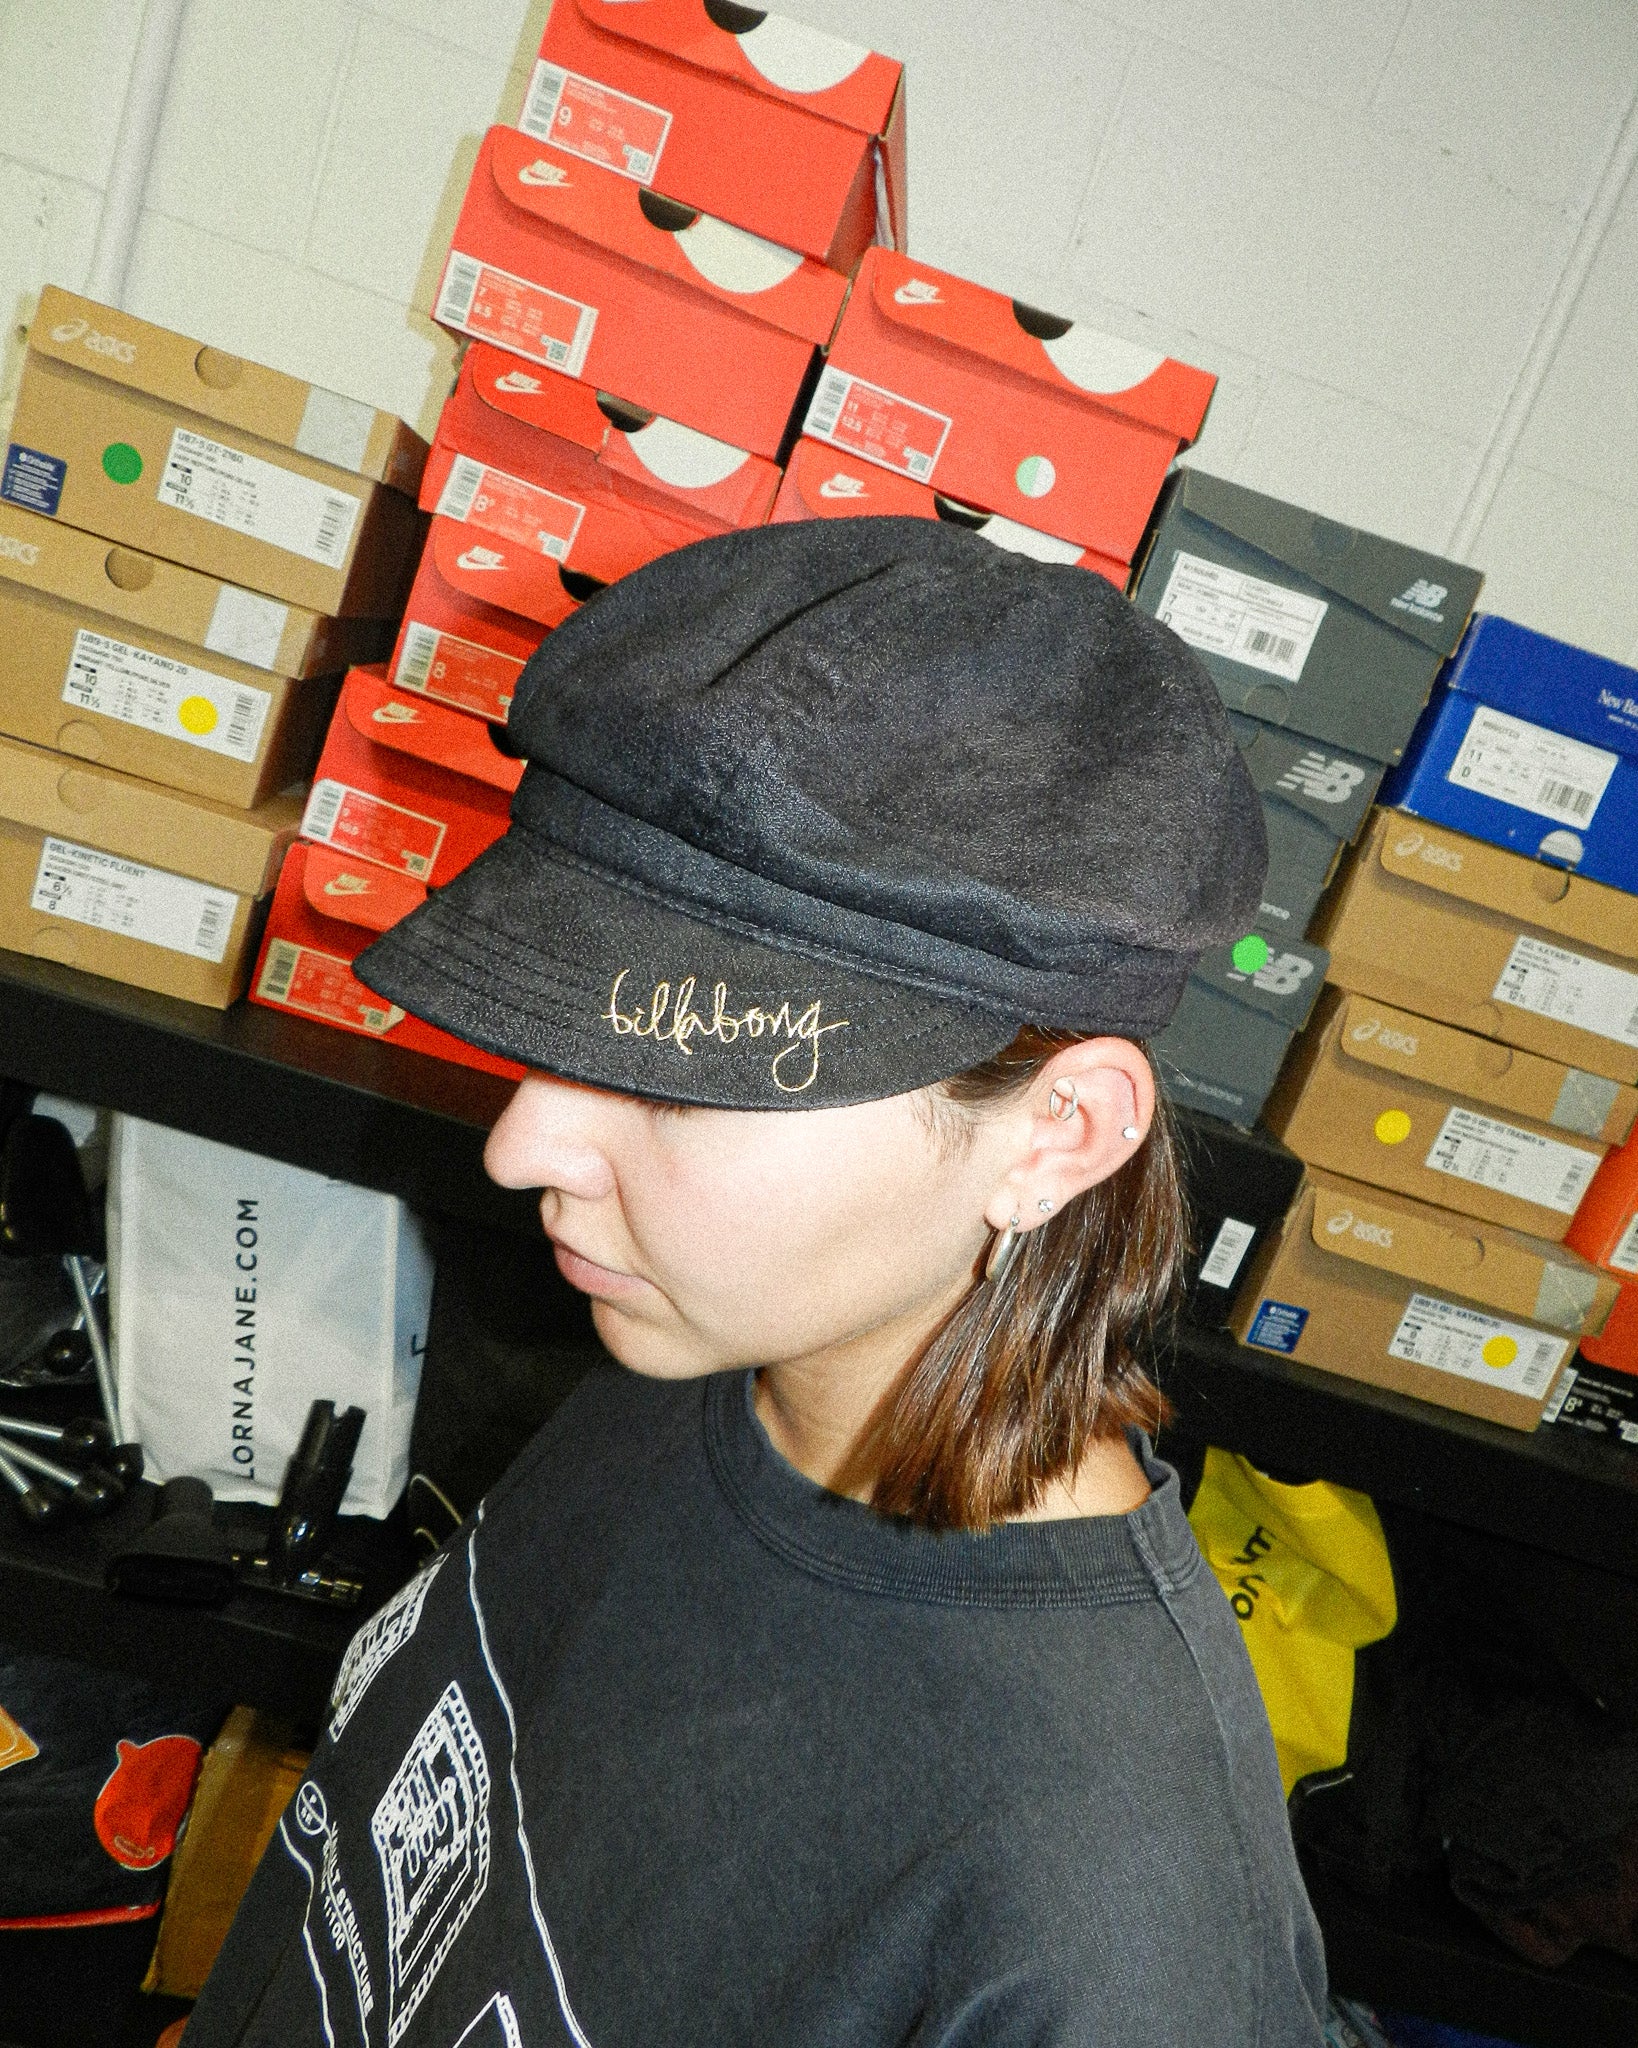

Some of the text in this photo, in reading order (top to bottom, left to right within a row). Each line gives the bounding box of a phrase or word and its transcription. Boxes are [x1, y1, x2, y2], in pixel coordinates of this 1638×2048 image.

[558, 106, 572, 125] 9
[179, 473, 192, 485] 10
[84, 674, 97, 685] 10
[176, 666, 187, 674] 20
[433, 662, 446, 678] 8
[1598, 688, 1638, 716] New Ba
[232, 1199, 260, 1481] LORNAJANE.COM
[323, 1895, 346, 1951] 1:100
[336, 1887, 374, 2018] STRUCTURE
